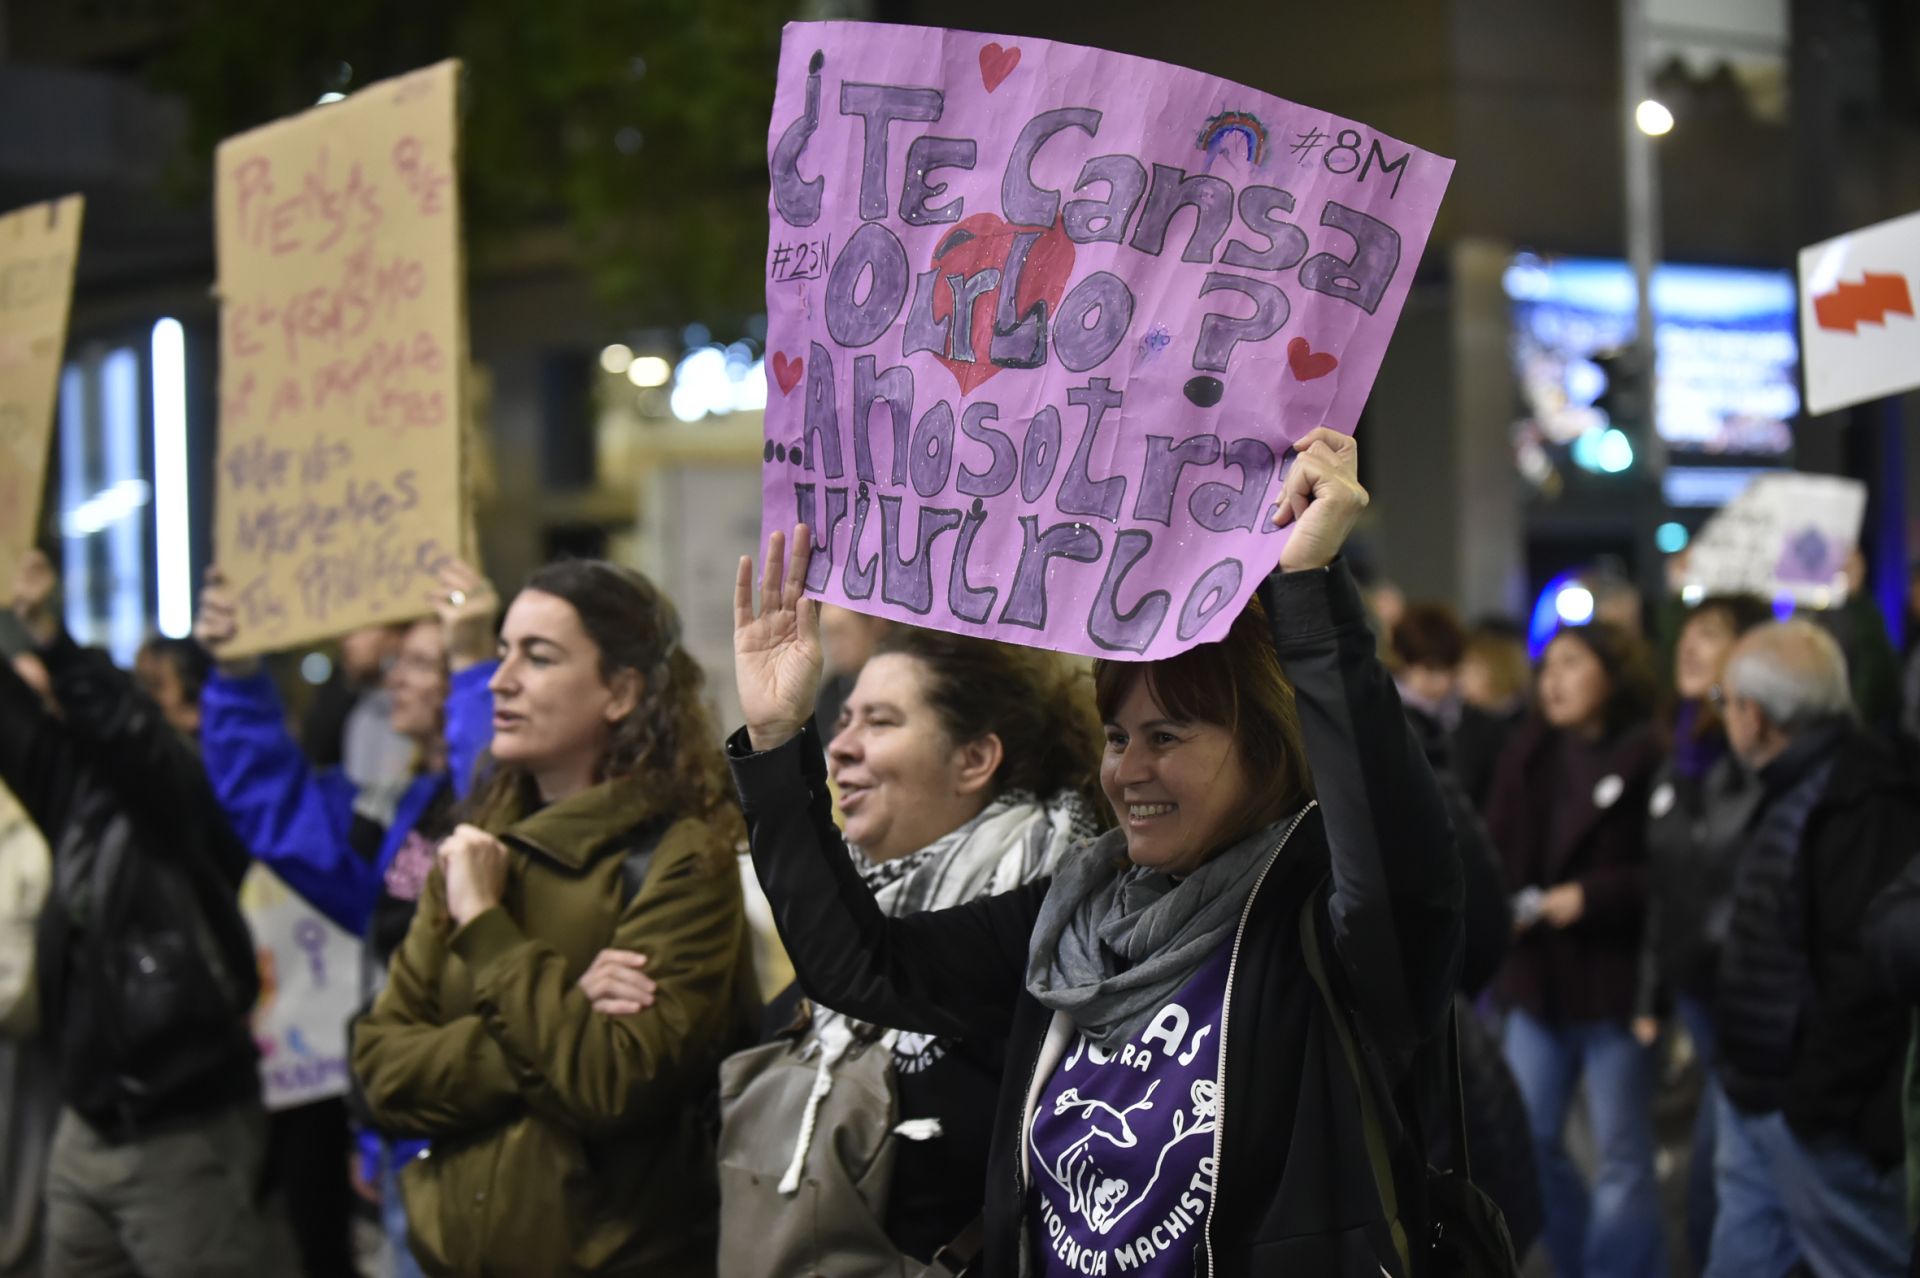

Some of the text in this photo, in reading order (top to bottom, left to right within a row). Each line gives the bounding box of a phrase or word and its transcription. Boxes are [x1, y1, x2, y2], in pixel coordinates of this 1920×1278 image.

[1001, 107, 1400, 315] Cansa
[1290, 126, 1410, 199] #8M
[771, 232, 831, 280] #25N
[853, 354, 1300, 534] nosotra
